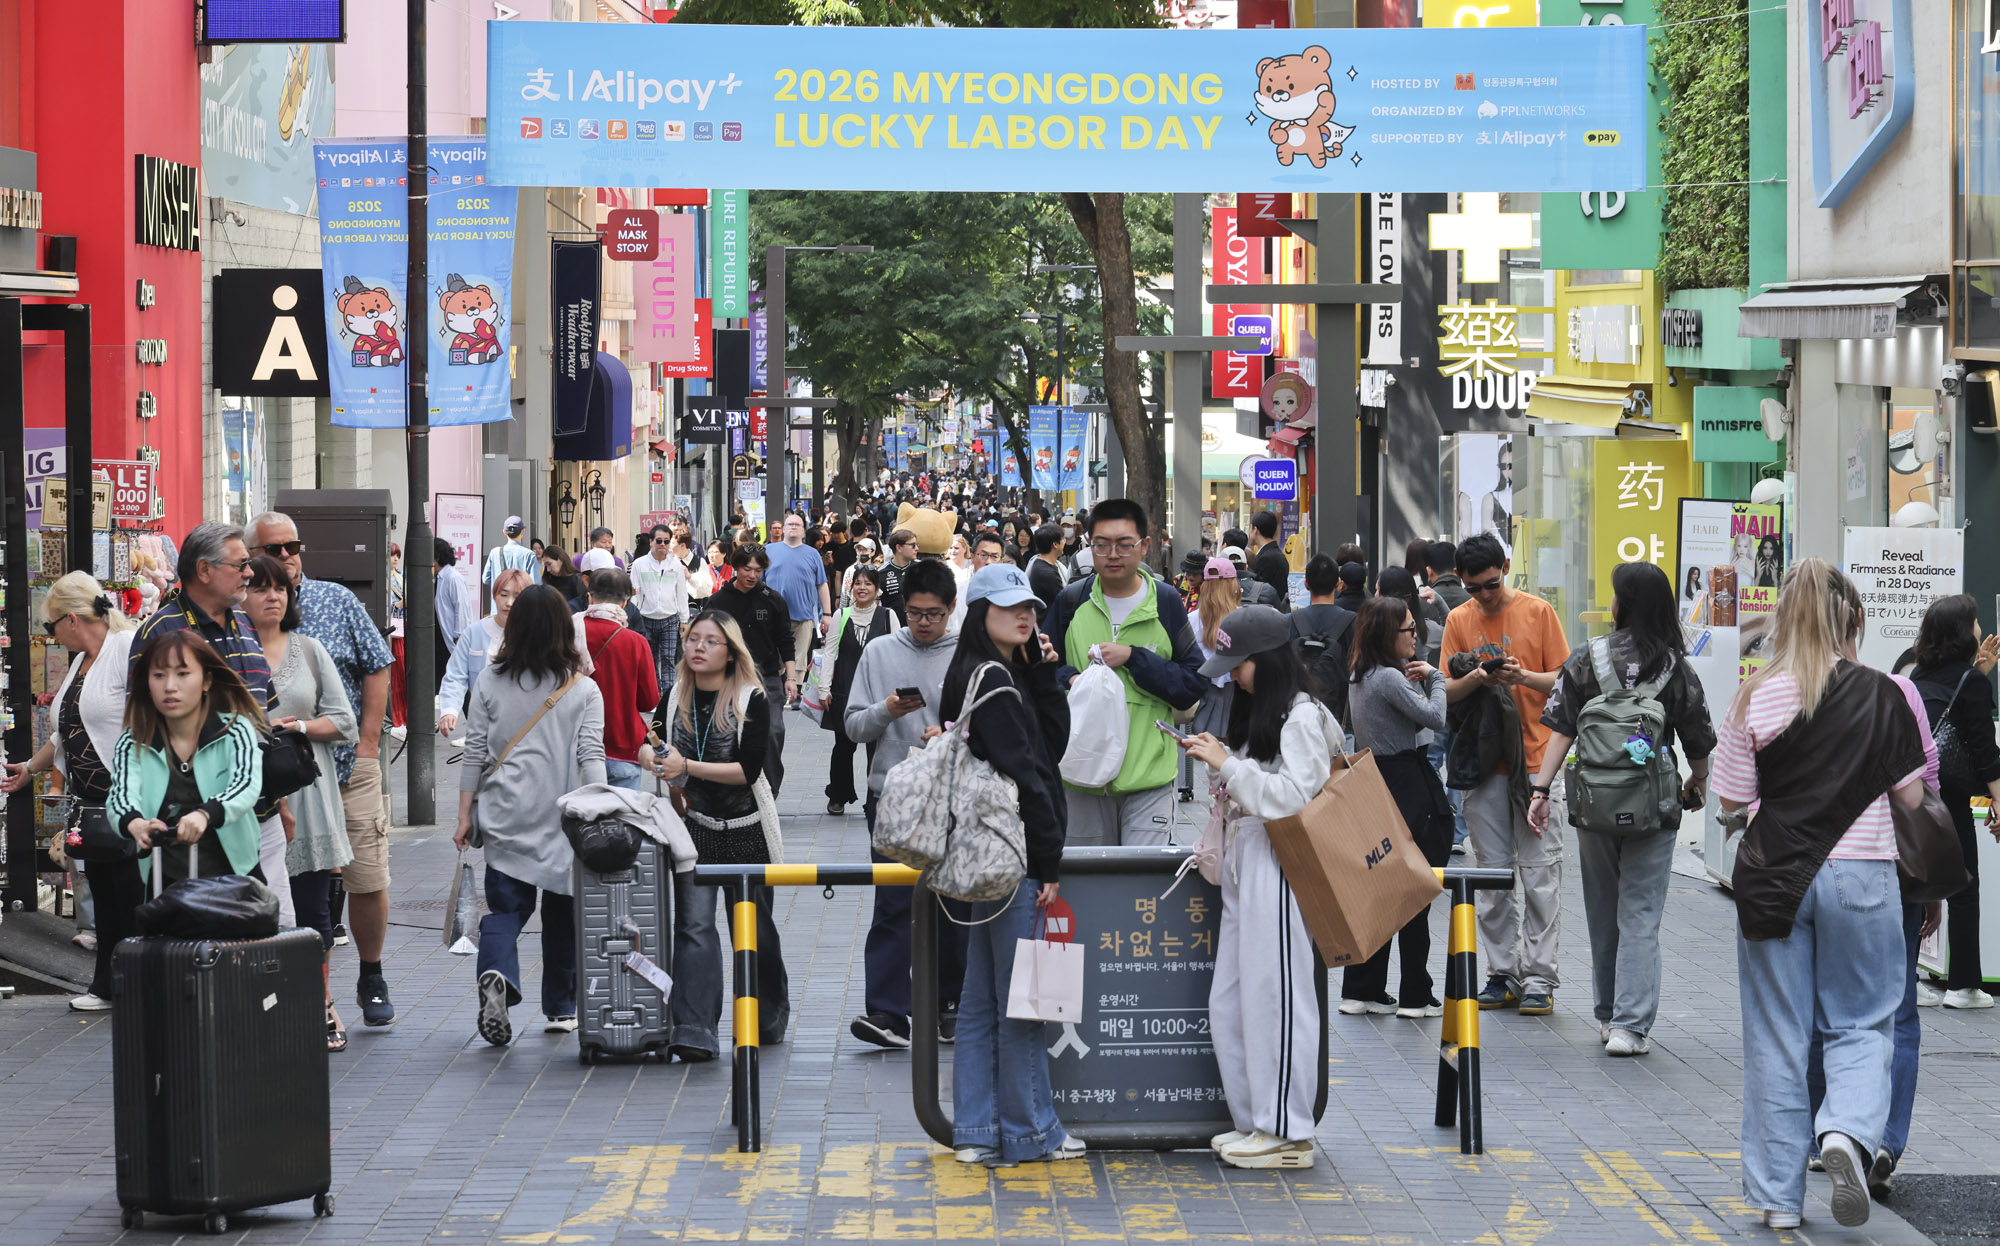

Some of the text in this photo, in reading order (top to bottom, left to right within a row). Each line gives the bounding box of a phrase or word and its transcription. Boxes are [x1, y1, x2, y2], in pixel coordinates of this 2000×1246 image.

[774, 68, 1223, 105] 2026 MYEONGDONG
[1371, 79, 1421, 89] HOSTED
[1424, 78, 1440, 89] BY
[1371, 105, 1586, 117] ORGANIZED BY PPLNETWORKS
[724, 129, 740, 139] Pay
[775, 112, 1223, 150] LUCKY LABOR DAY
[1371, 133, 1445, 144] SUPPORTED
[1448, 133, 1464, 143] BY
[1598, 133, 1616, 143] pay
[143, 154, 200, 251] MISSHA
[624, 217, 642, 227] ALL
[617, 230, 647, 240] MASK
[616, 243, 649, 253] STORY
[723, 189, 736, 311] URE REPUBLIC
[652, 237, 675, 339] ETUDE
[578, 297, 593, 351] Rockfish
[1238, 325, 1266, 335] QUEEN
[567, 303, 580, 381] Weatherwear
[1441, 301, 1519, 378] 藥
[692, 409, 722, 424] VT
[28, 452, 54, 476] IG
[101, 468, 147, 488] ALE
[1258, 470, 1288, 479] QUEEN
[1762, 470, 1784, 479] SPE
[1256, 482, 1294, 491] HOLIDAY
[1617, 461, 1665, 511] 药
[1692, 524, 1719, 534] HAIR
[1731, 514, 1780, 539] NAIL
[1882, 550, 1924, 561] Reveal
[1850, 563, 1956, 576] Firmness & Radiance
[1007, 572, 1025, 586] CK
[1876, 578, 1931, 590] in 28 Days
[1753, 588, 1768, 600] Art
[1365, 837, 1393, 870] MLB
[1334, 953, 1351, 963] MLB
[1099, 962, 1122, 972] 걸으면
[1163, 961, 1187, 971] 서울이
[1189, 961, 1216, 971] 행복해
[1099, 994, 1139, 1006] 운영시간
[1100, 1018, 1211, 1038] 매일 10:00~2
[1069, 1089, 1117, 1103] 중구청장
